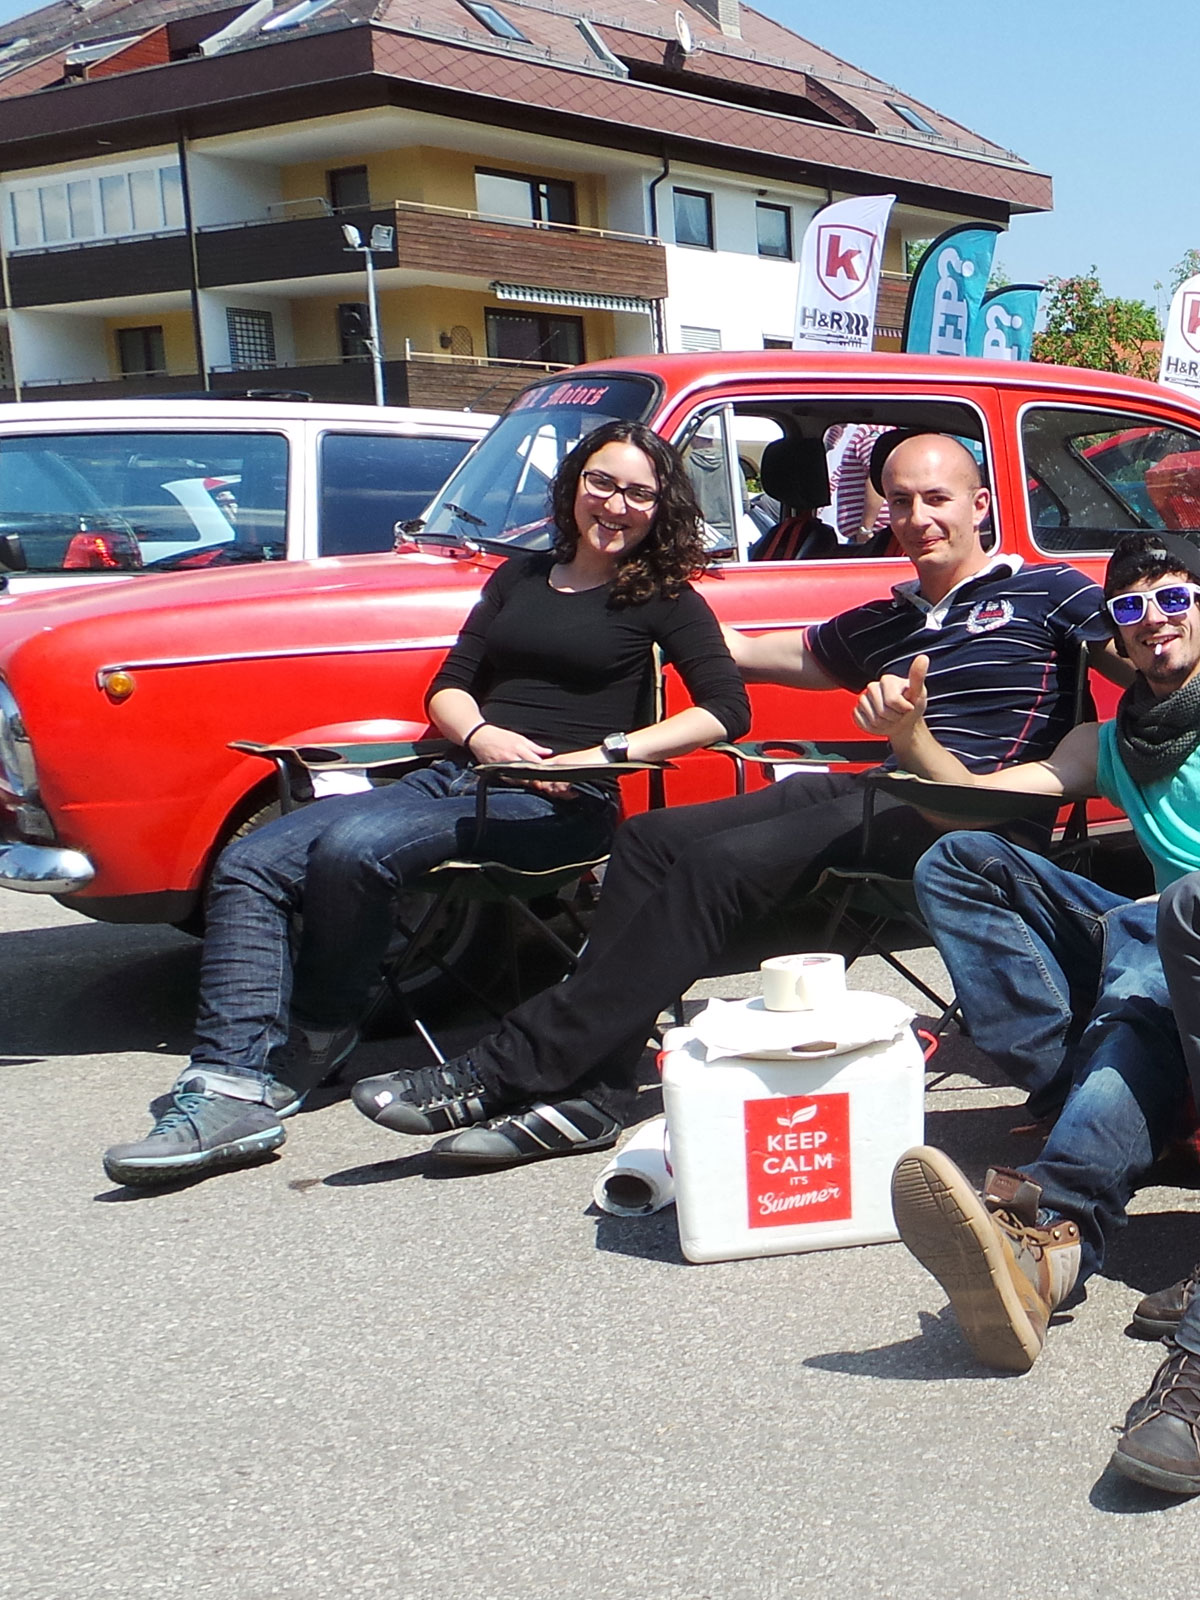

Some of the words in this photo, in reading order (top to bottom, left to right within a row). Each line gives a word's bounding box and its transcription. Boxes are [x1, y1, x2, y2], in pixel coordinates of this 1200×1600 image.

[801, 306, 843, 331] H&R
[1166, 356, 1199, 377] H&R
[767, 1131, 828, 1152] KEEP
[763, 1153, 833, 1174] CALM
[758, 1187, 840, 1215] Summer
